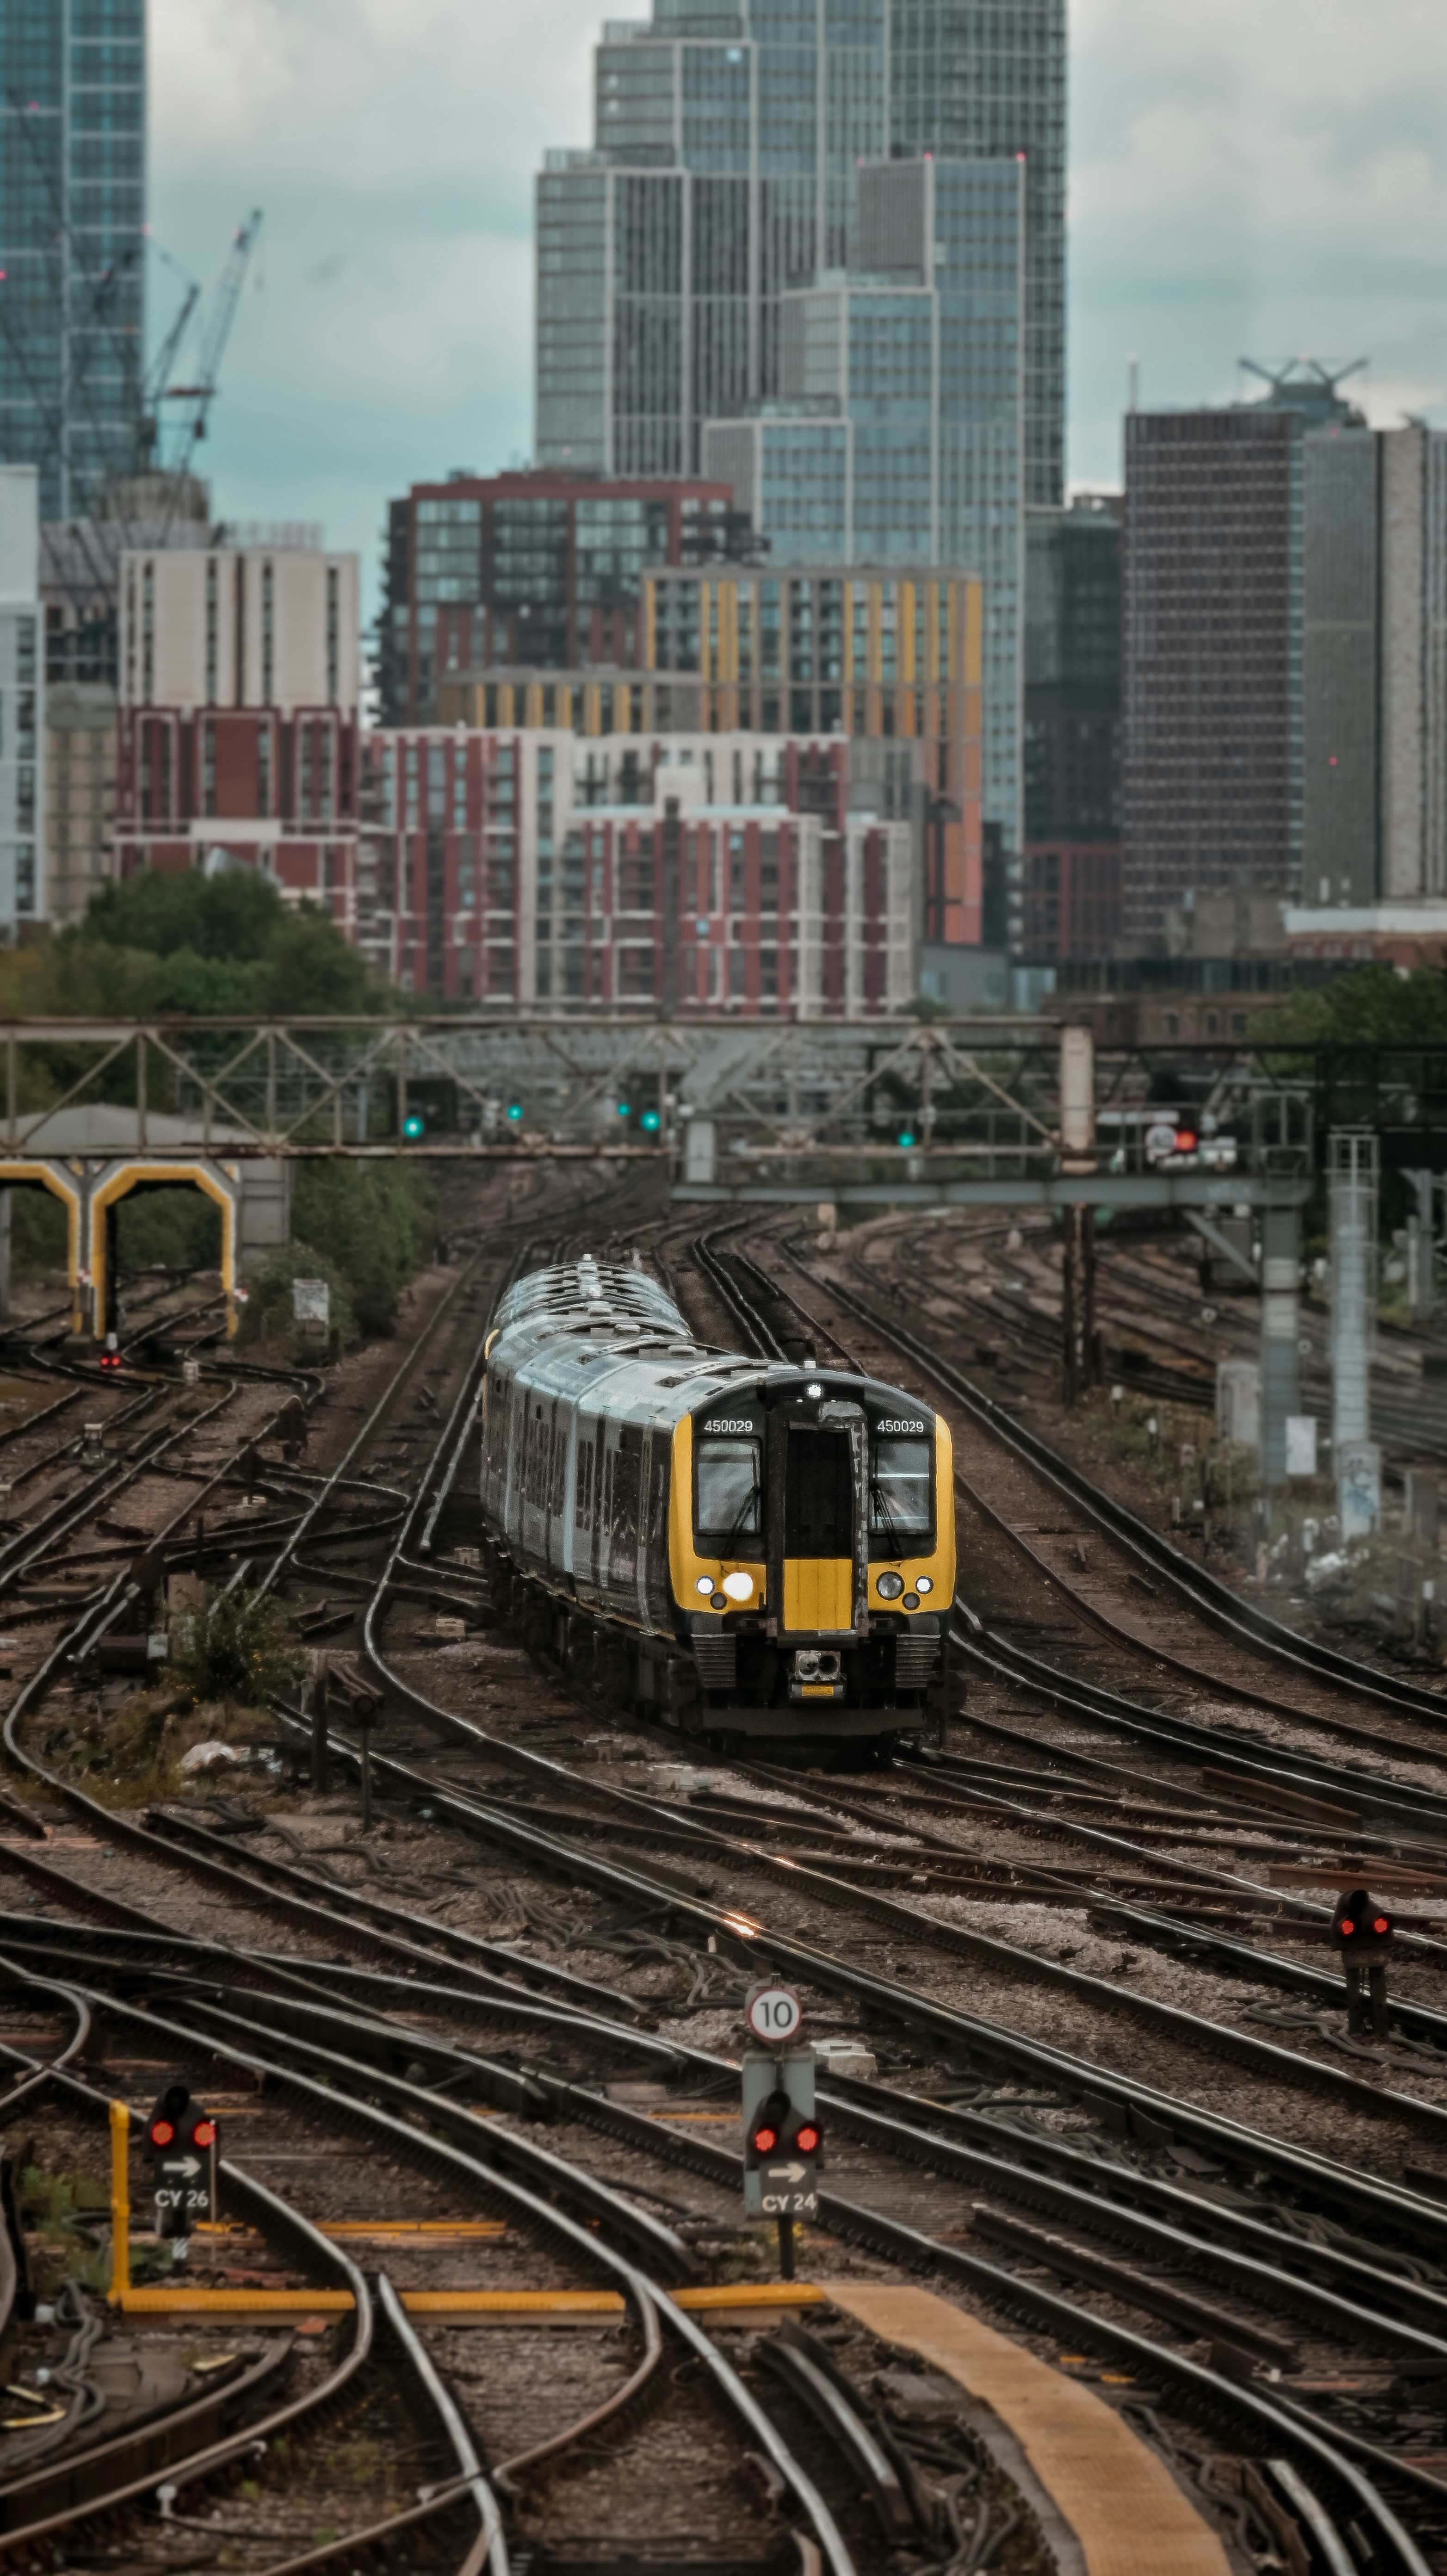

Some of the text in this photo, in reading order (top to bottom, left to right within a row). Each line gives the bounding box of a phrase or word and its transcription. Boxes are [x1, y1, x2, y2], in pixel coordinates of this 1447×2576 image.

[704, 1420, 753, 1432] 450029
[877, 1420, 924, 1432] 450029
[760, 2001, 792, 2028] 10
[155, 2189, 209, 2207] CY 26
[762, 2192, 817, 2212] CY 24
